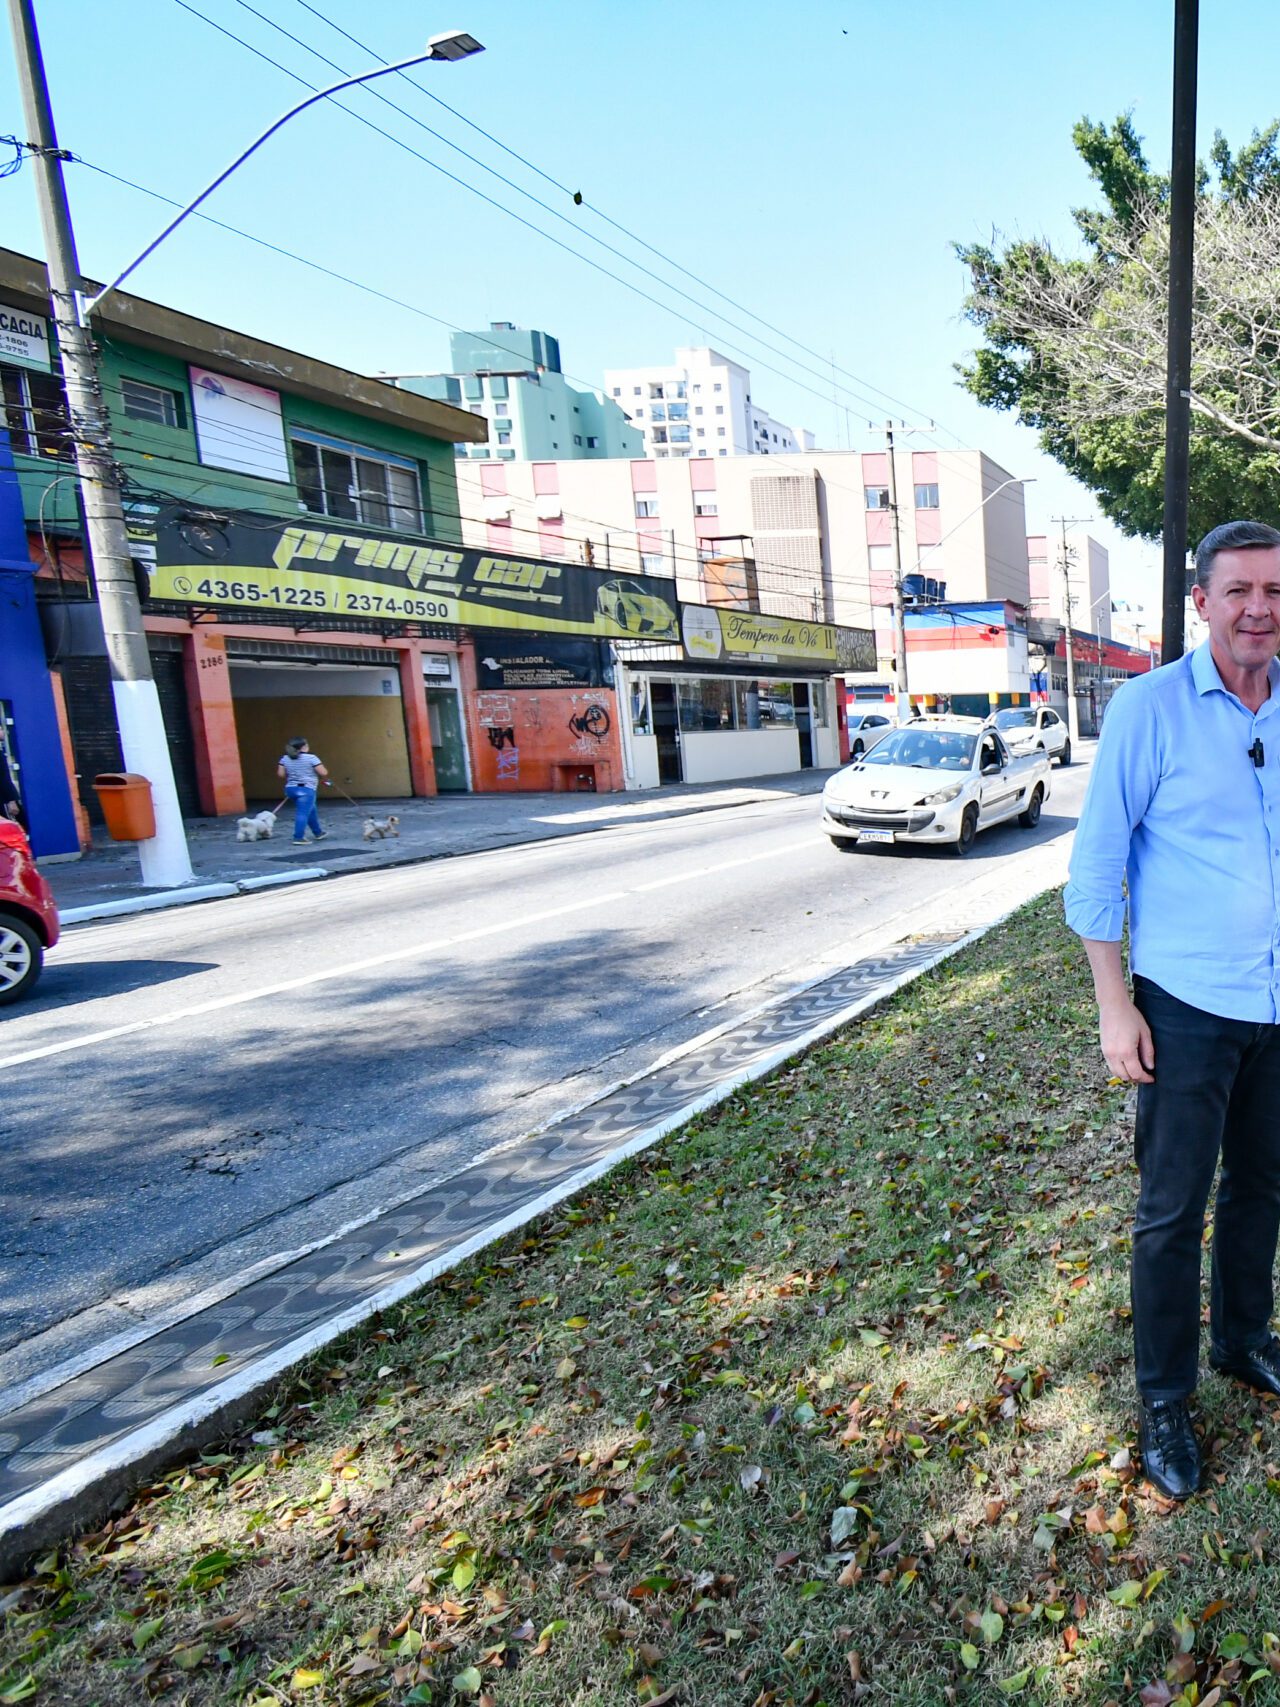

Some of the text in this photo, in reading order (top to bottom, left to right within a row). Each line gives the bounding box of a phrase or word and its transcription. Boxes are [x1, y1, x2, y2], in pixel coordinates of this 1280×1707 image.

[197, 578, 327, 607] 4365-1225
[346, 593, 449, 618] 2374-0590
[727, 615, 780, 649] Tempero
[781, 629, 795, 646] da
[799, 626, 823, 648] Vó
